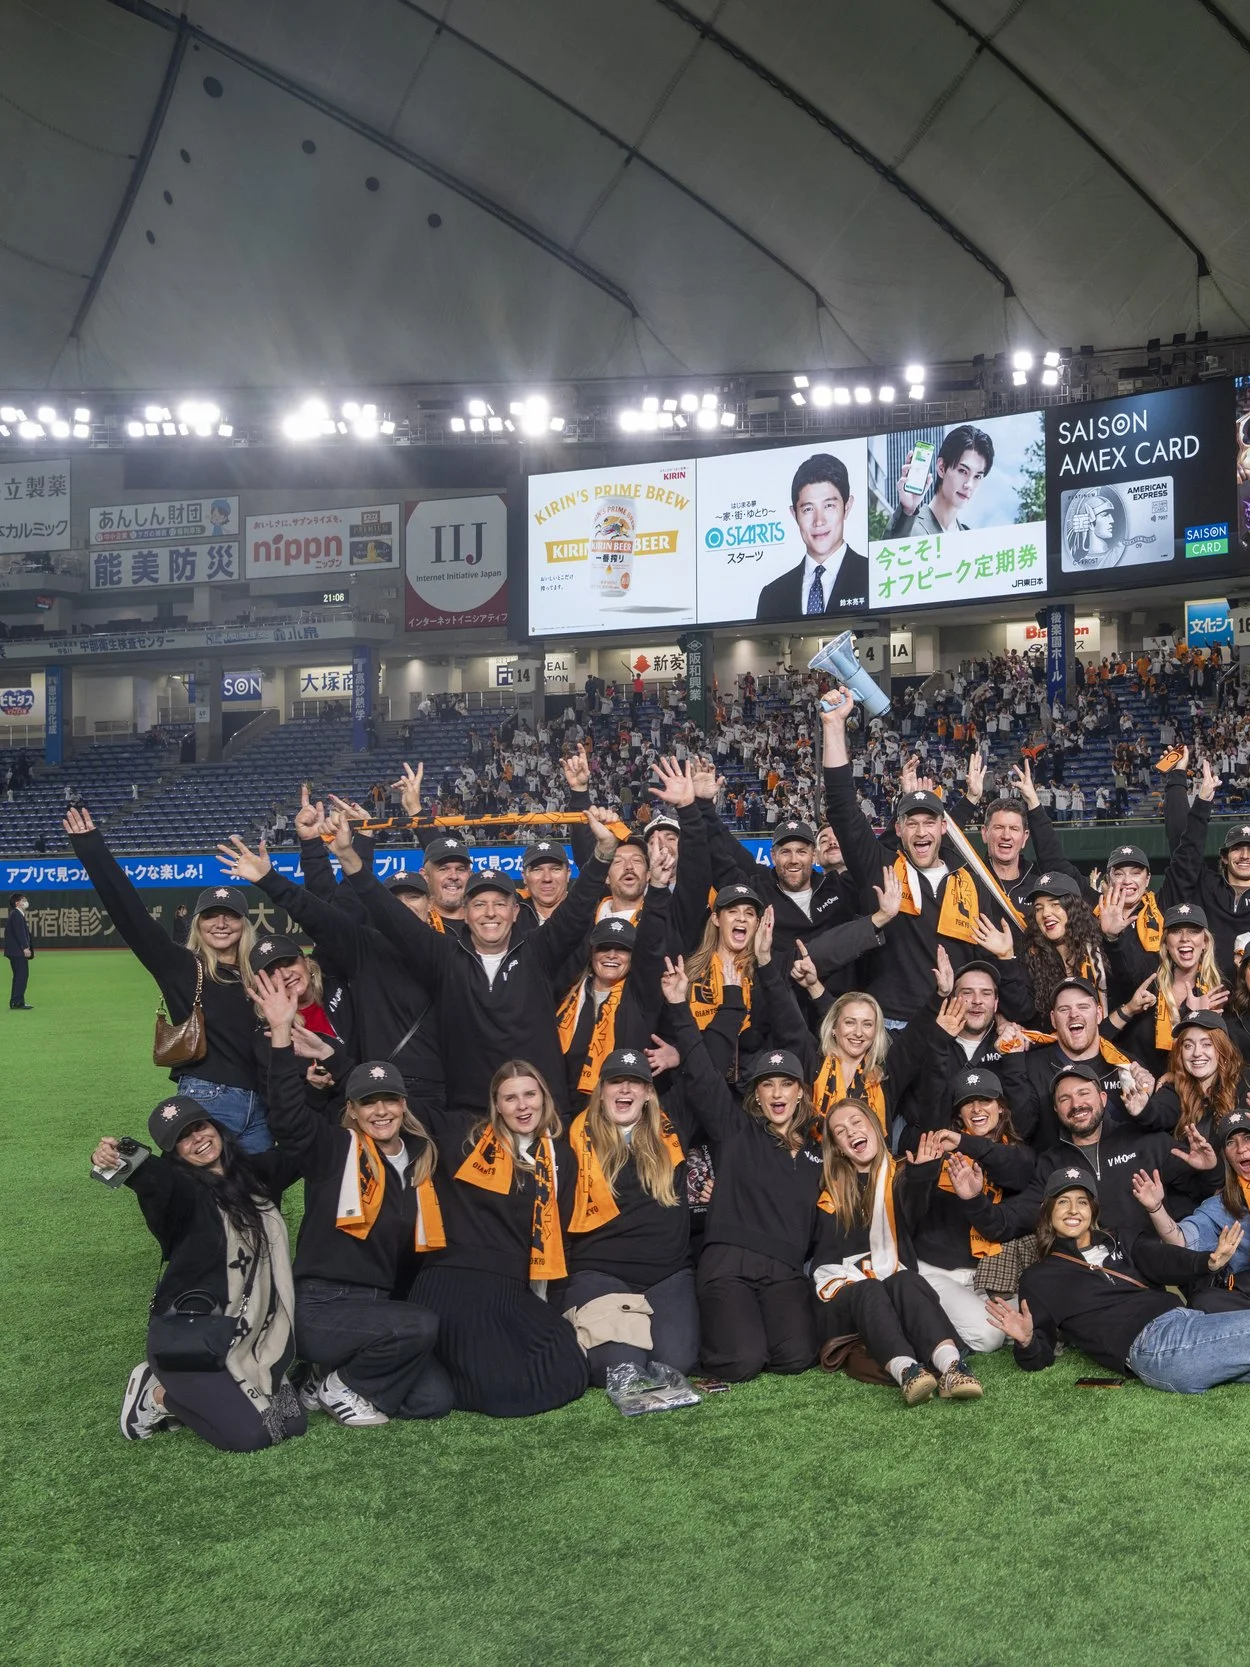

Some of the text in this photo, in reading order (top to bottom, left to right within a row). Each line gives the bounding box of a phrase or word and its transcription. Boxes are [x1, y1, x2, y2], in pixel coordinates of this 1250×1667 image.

[1058, 410, 1148, 446] SAISON
[1059, 435, 1200, 477] AMEX CARD
[663, 471, 686, 481] KIRIN
[1127, 483, 1168, 494] AMERICAN
[1133, 490, 1168, 501] EXPRESS
[534, 489, 589, 526] KIRIN'S
[594, 483, 642, 499] PRIME
[645, 484, 691, 511] BREW
[100, 503, 202, 529] あんしん財団
[727, 521, 785, 547] STARTS
[1186, 526, 1227, 541] SAISON
[253, 533, 342, 566] nippn
[431, 522, 487, 566] IIJ
[613, 543, 632, 551] BEER
[1191, 541, 1222, 555] CARD
[315, 559, 342, 569] ニップン
[596, 553, 624, 563] 一番搾り
[727, 551, 764, 565] スターツ
[94, 544, 234, 587] 能美防災
[878, 543, 1038, 599] オフピーク定期券
[416, 570, 502, 582] Internet Initiative Japan
[1011, 576, 1044, 589] JR東日本
[323, 593, 344, 603] 21:06
[1051, 611, 1062, 683] 後楽園ホール
[517, 668, 530, 682] 14
[689, 652, 702, 701] 阪和興業
[695, 1008, 718, 1018] GIANTS
[472, 1163, 496, 1175] GIANTS
